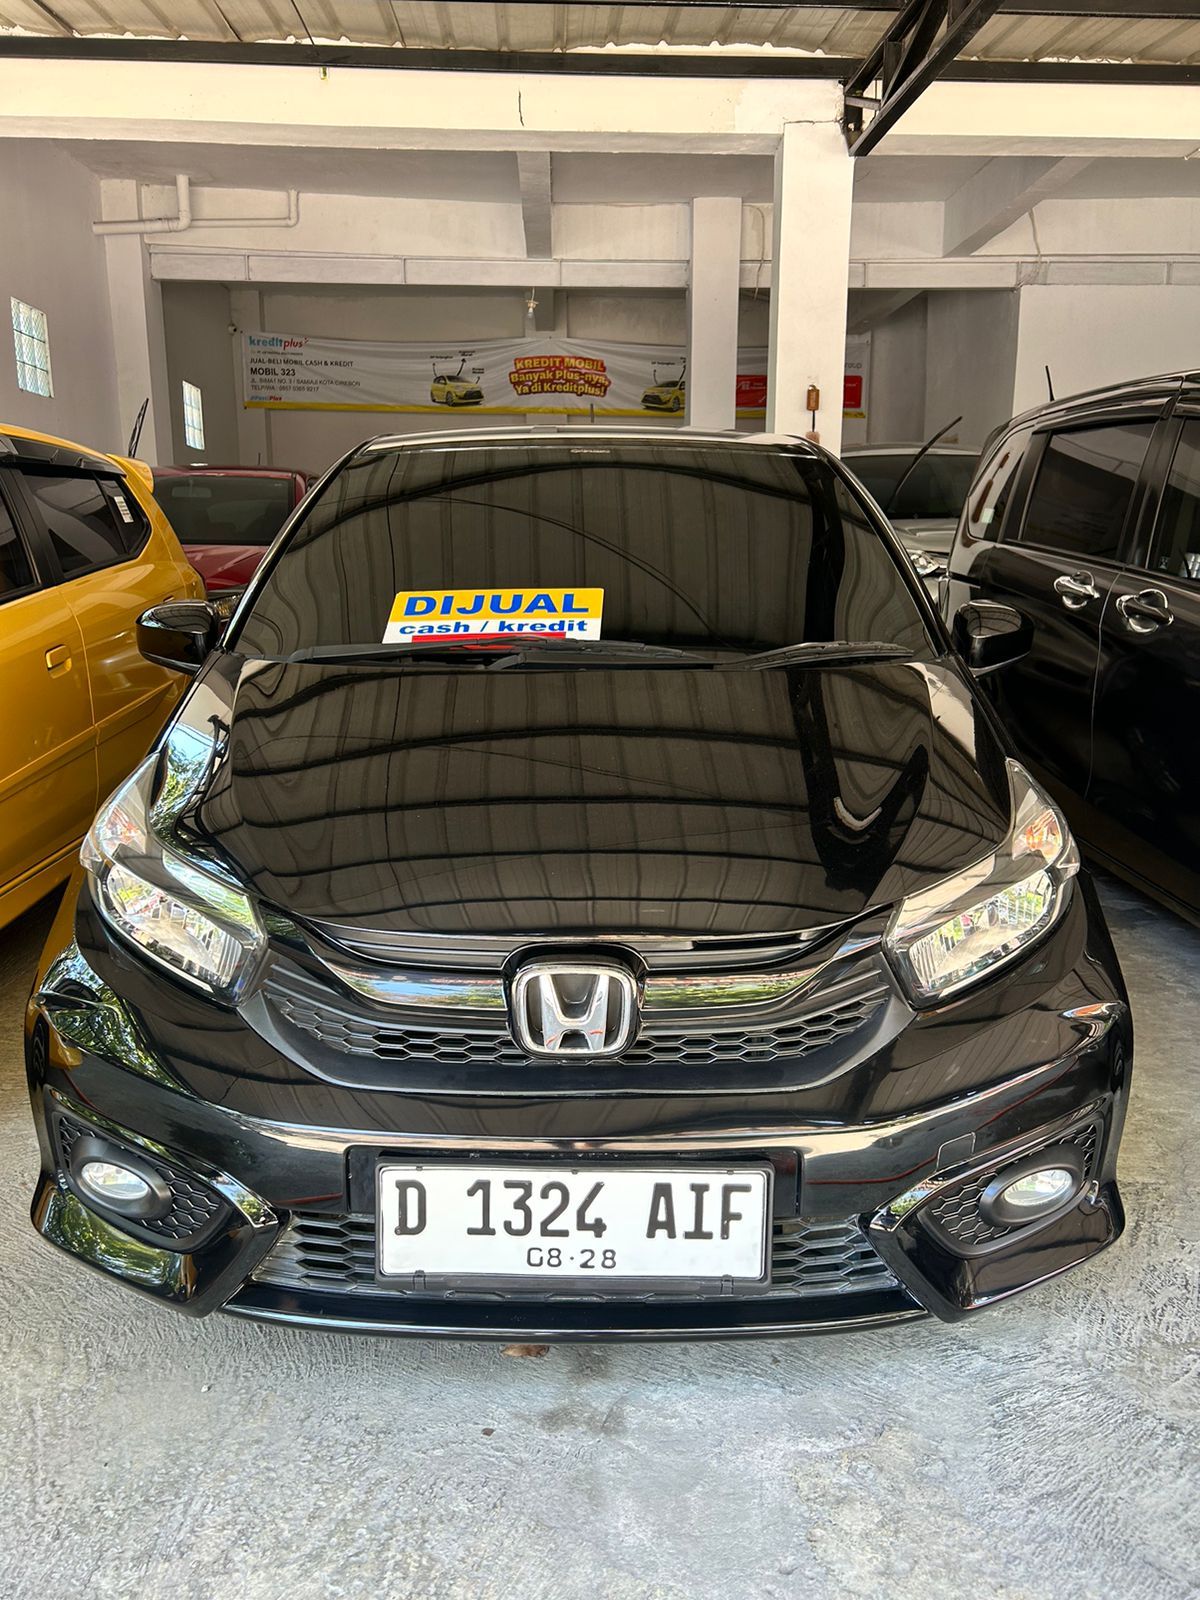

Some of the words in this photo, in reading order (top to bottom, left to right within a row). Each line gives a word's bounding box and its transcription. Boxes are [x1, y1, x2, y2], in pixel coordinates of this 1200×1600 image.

[249, 335, 303, 350] kreditplus
[283, 358, 304, 366] MOBIL
[304, 359, 323, 367] CASH
[516, 358, 561, 369] KREDIT
[564, 357, 604, 371] MOBIL
[250, 367, 279, 376] MOBIL
[280, 368, 296, 377] 323
[510, 370, 553, 383] Banyak
[555, 370, 609, 385] Plus-nya,
[516, 384, 529, 394] Ya
[531, 382, 542, 392] di
[544, 382, 605, 396] Kreditplus!
[404, 593, 589, 616] DIJUAL
[399, 621, 470, 634] cash
[480, 621, 489, 632] /
[498, 620, 588, 632] kredit
[394, 1179, 427, 1236] D
[466, 1179, 607, 1238] 1324
[646, 1182, 752, 1240] AIF
